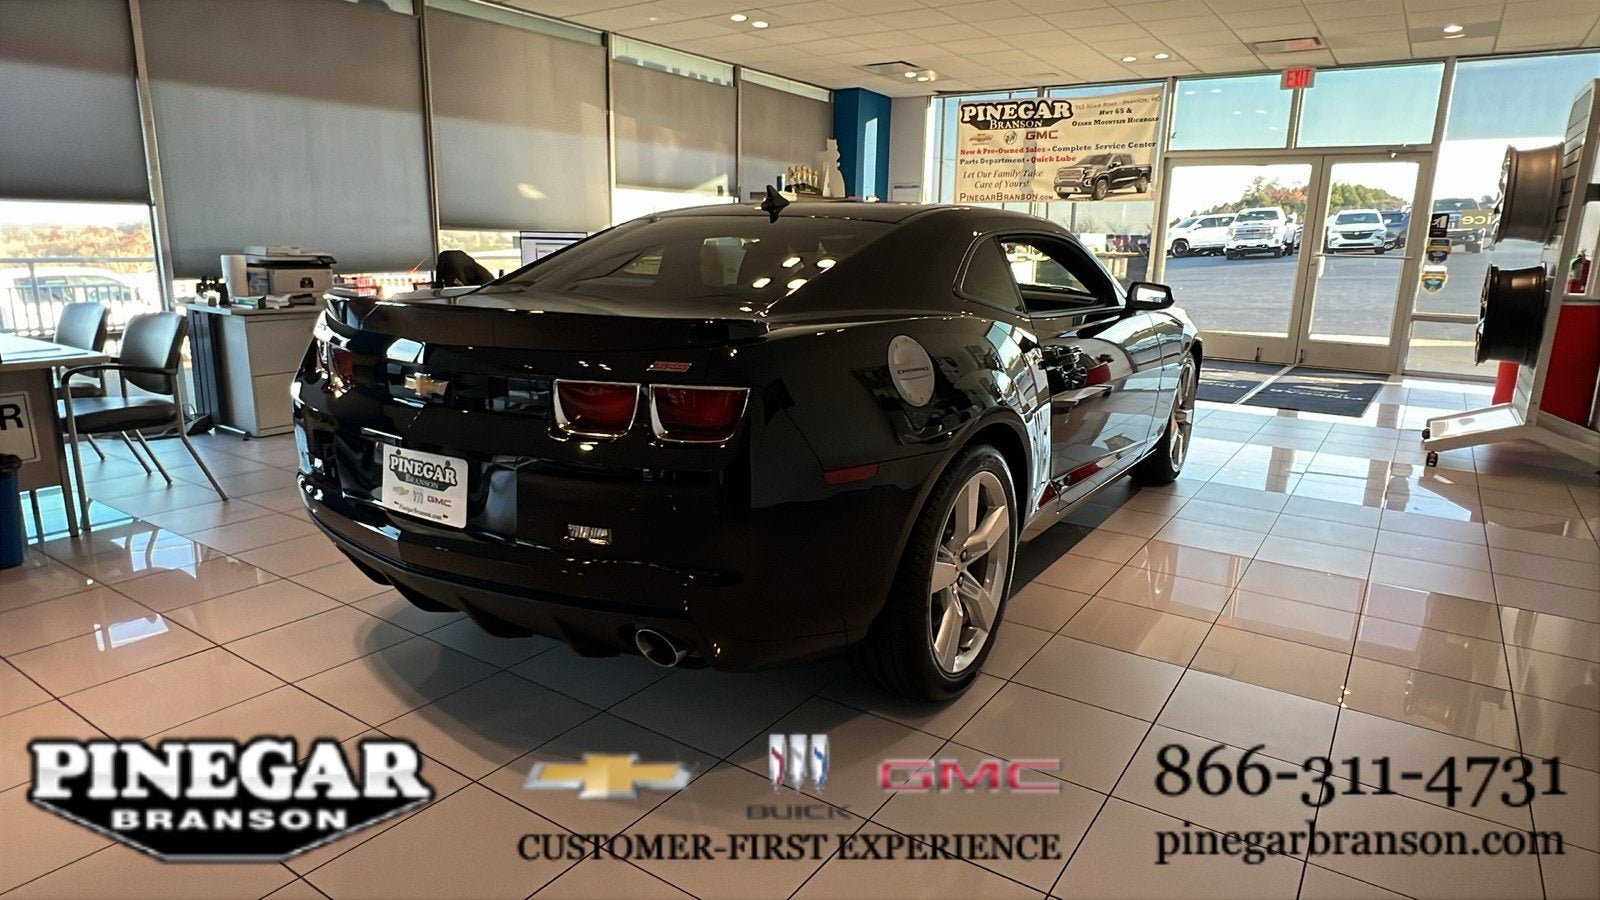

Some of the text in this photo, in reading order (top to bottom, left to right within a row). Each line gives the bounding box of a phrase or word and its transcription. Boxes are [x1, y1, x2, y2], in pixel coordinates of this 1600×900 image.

[1286, 68, 1311, 88] EXIT
[962, 101, 1073, 122] PINEGAR
[989, 119, 1043, 130] BRANSON
[1025, 130, 1058, 140] GMC
[982, 147, 1025, 155] Pre-Owned
[1052, 144, 1092, 153] Complete
[1094, 142, 1126, 150] Service
[1127, 141, 1157, 149] Center
[980, 157, 1025, 165] Department
[1031, 156, 1054, 164] Quick
[962, 169, 1044, 179] Let Our Family Take
[974, 180, 1030, 189] Care of Yours!
[390, 454, 457, 486] PINEGAR
[427, 495, 452, 507] GMC
